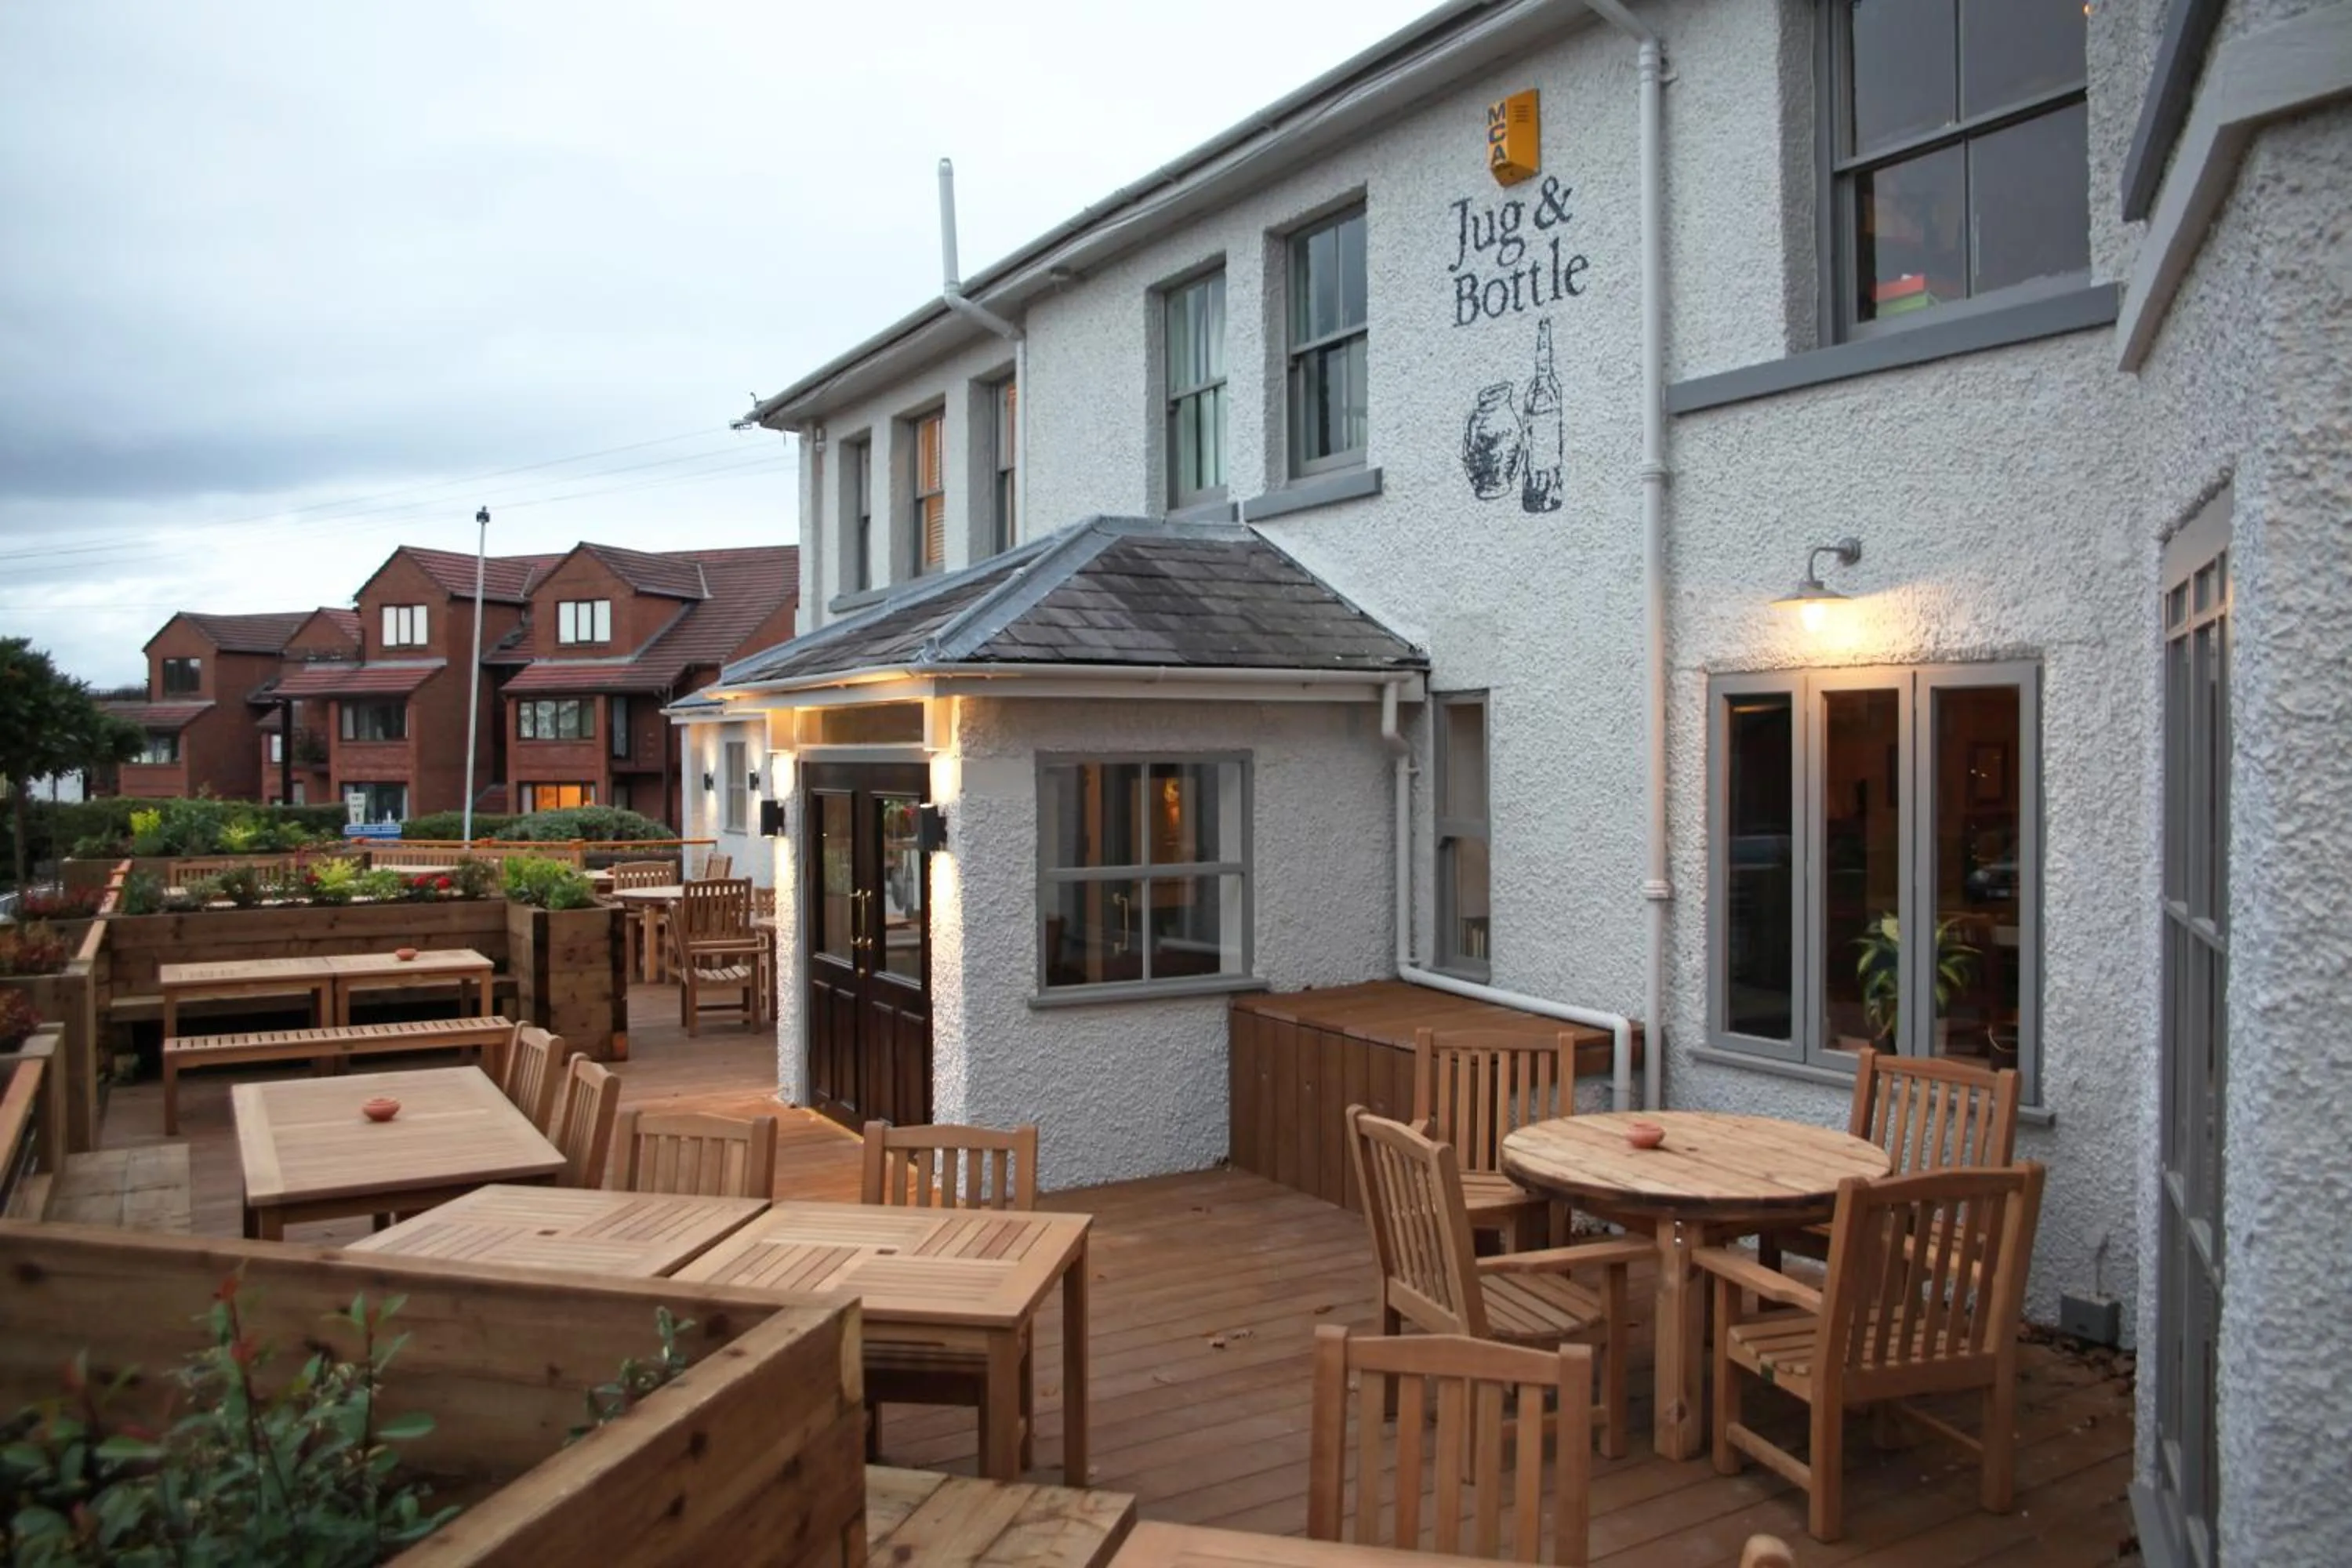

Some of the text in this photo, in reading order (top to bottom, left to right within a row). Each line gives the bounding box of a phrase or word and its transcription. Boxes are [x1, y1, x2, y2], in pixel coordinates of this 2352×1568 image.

[1488, 101, 1506, 167] MCA
[1449, 176, 1573, 271] Jug &
[1452, 237, 1588, 328] Bottle
